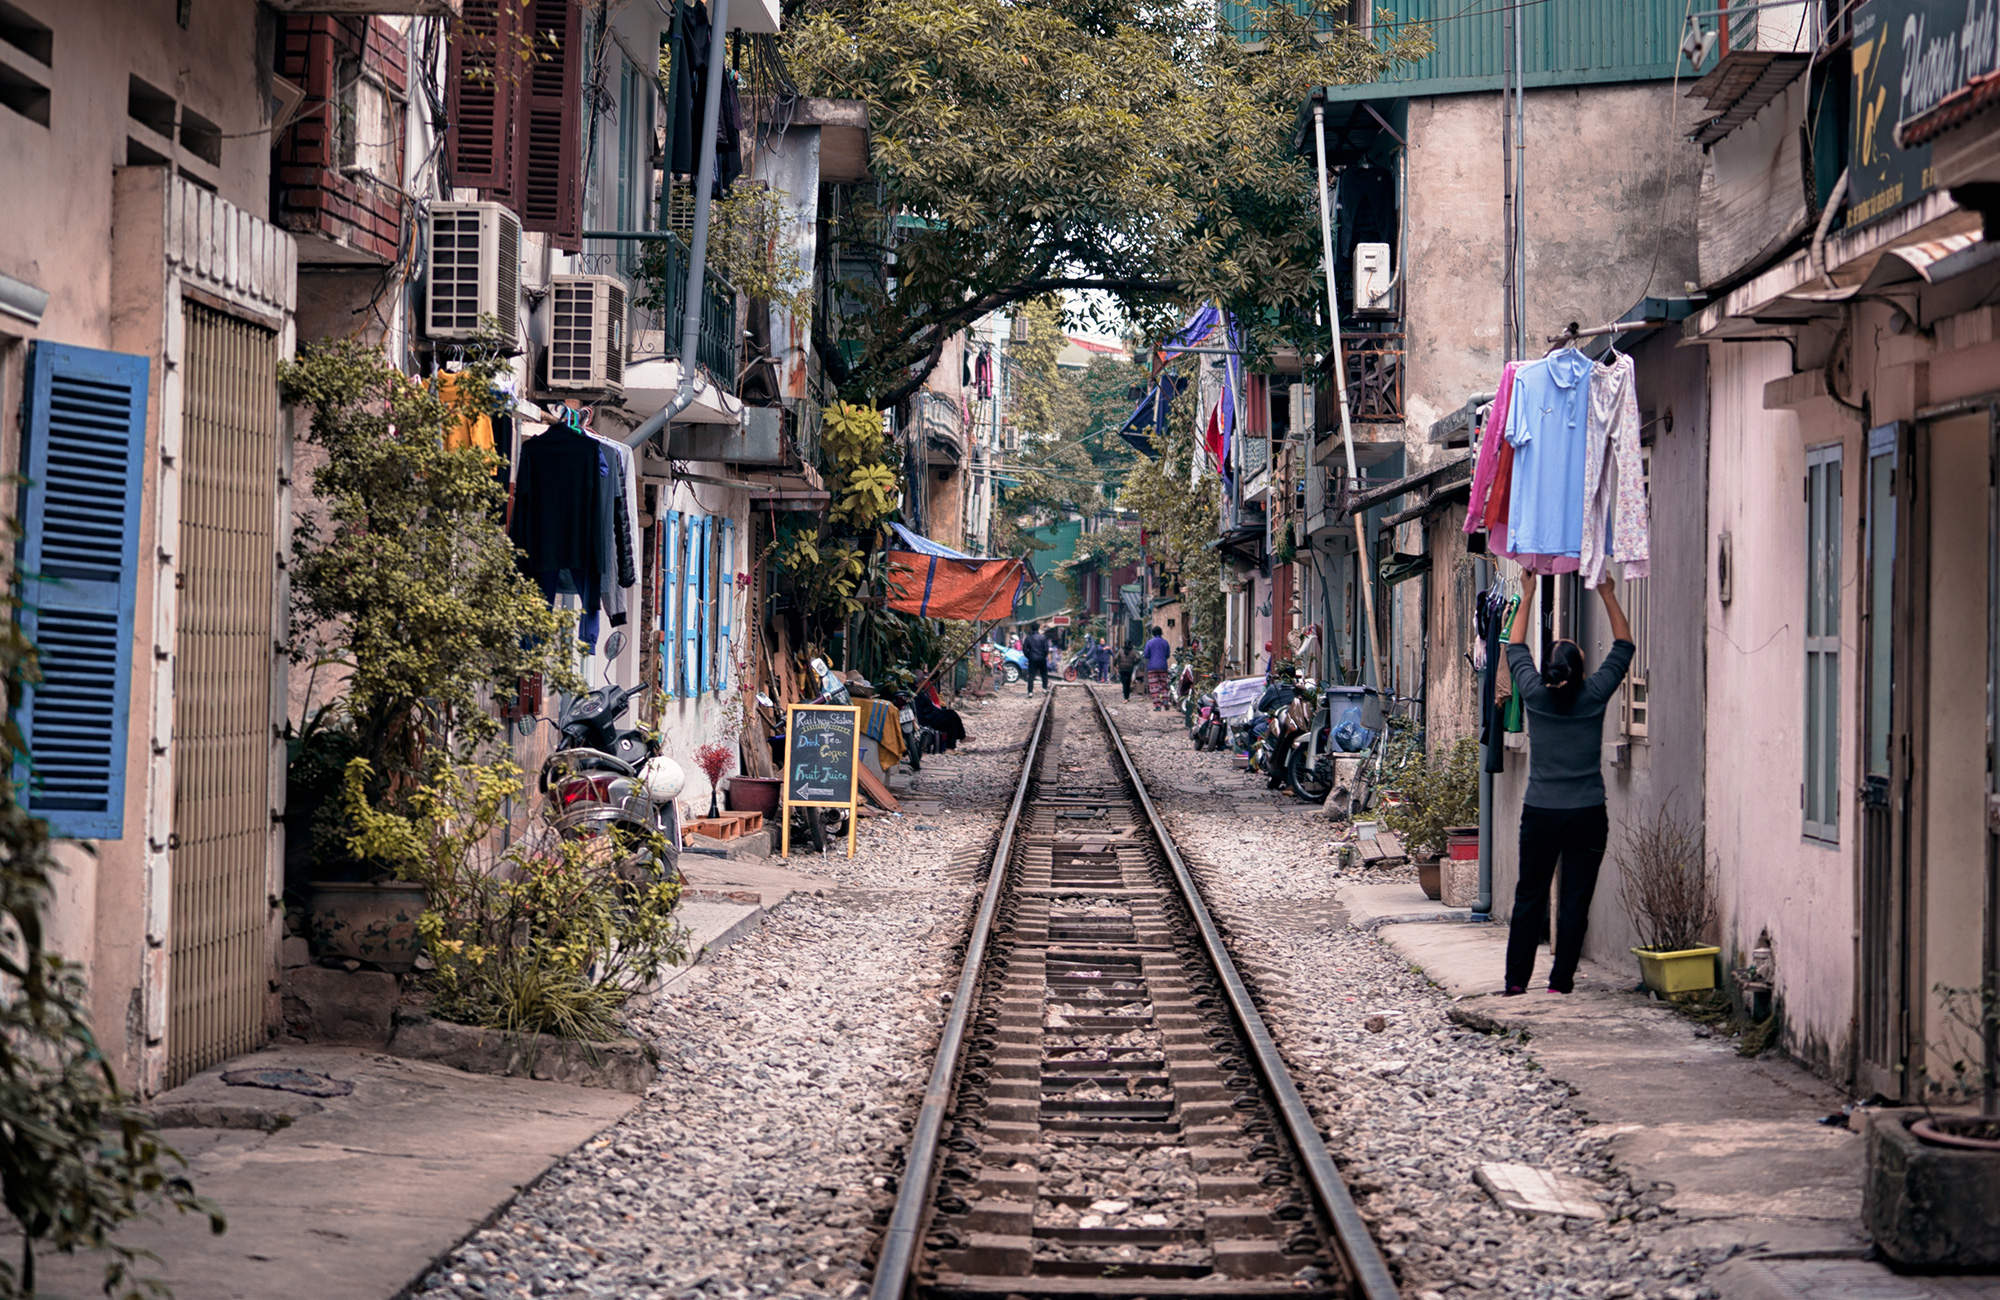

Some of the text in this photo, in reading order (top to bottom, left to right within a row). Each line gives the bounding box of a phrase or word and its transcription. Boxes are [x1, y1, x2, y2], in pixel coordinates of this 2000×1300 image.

[796, 711, 854, 732] Railway Station
[820, 732, 842, 745] Tea
[820, 744, 848, 763] Coffee
[795, 763, 848, 783] Fruit Juice
